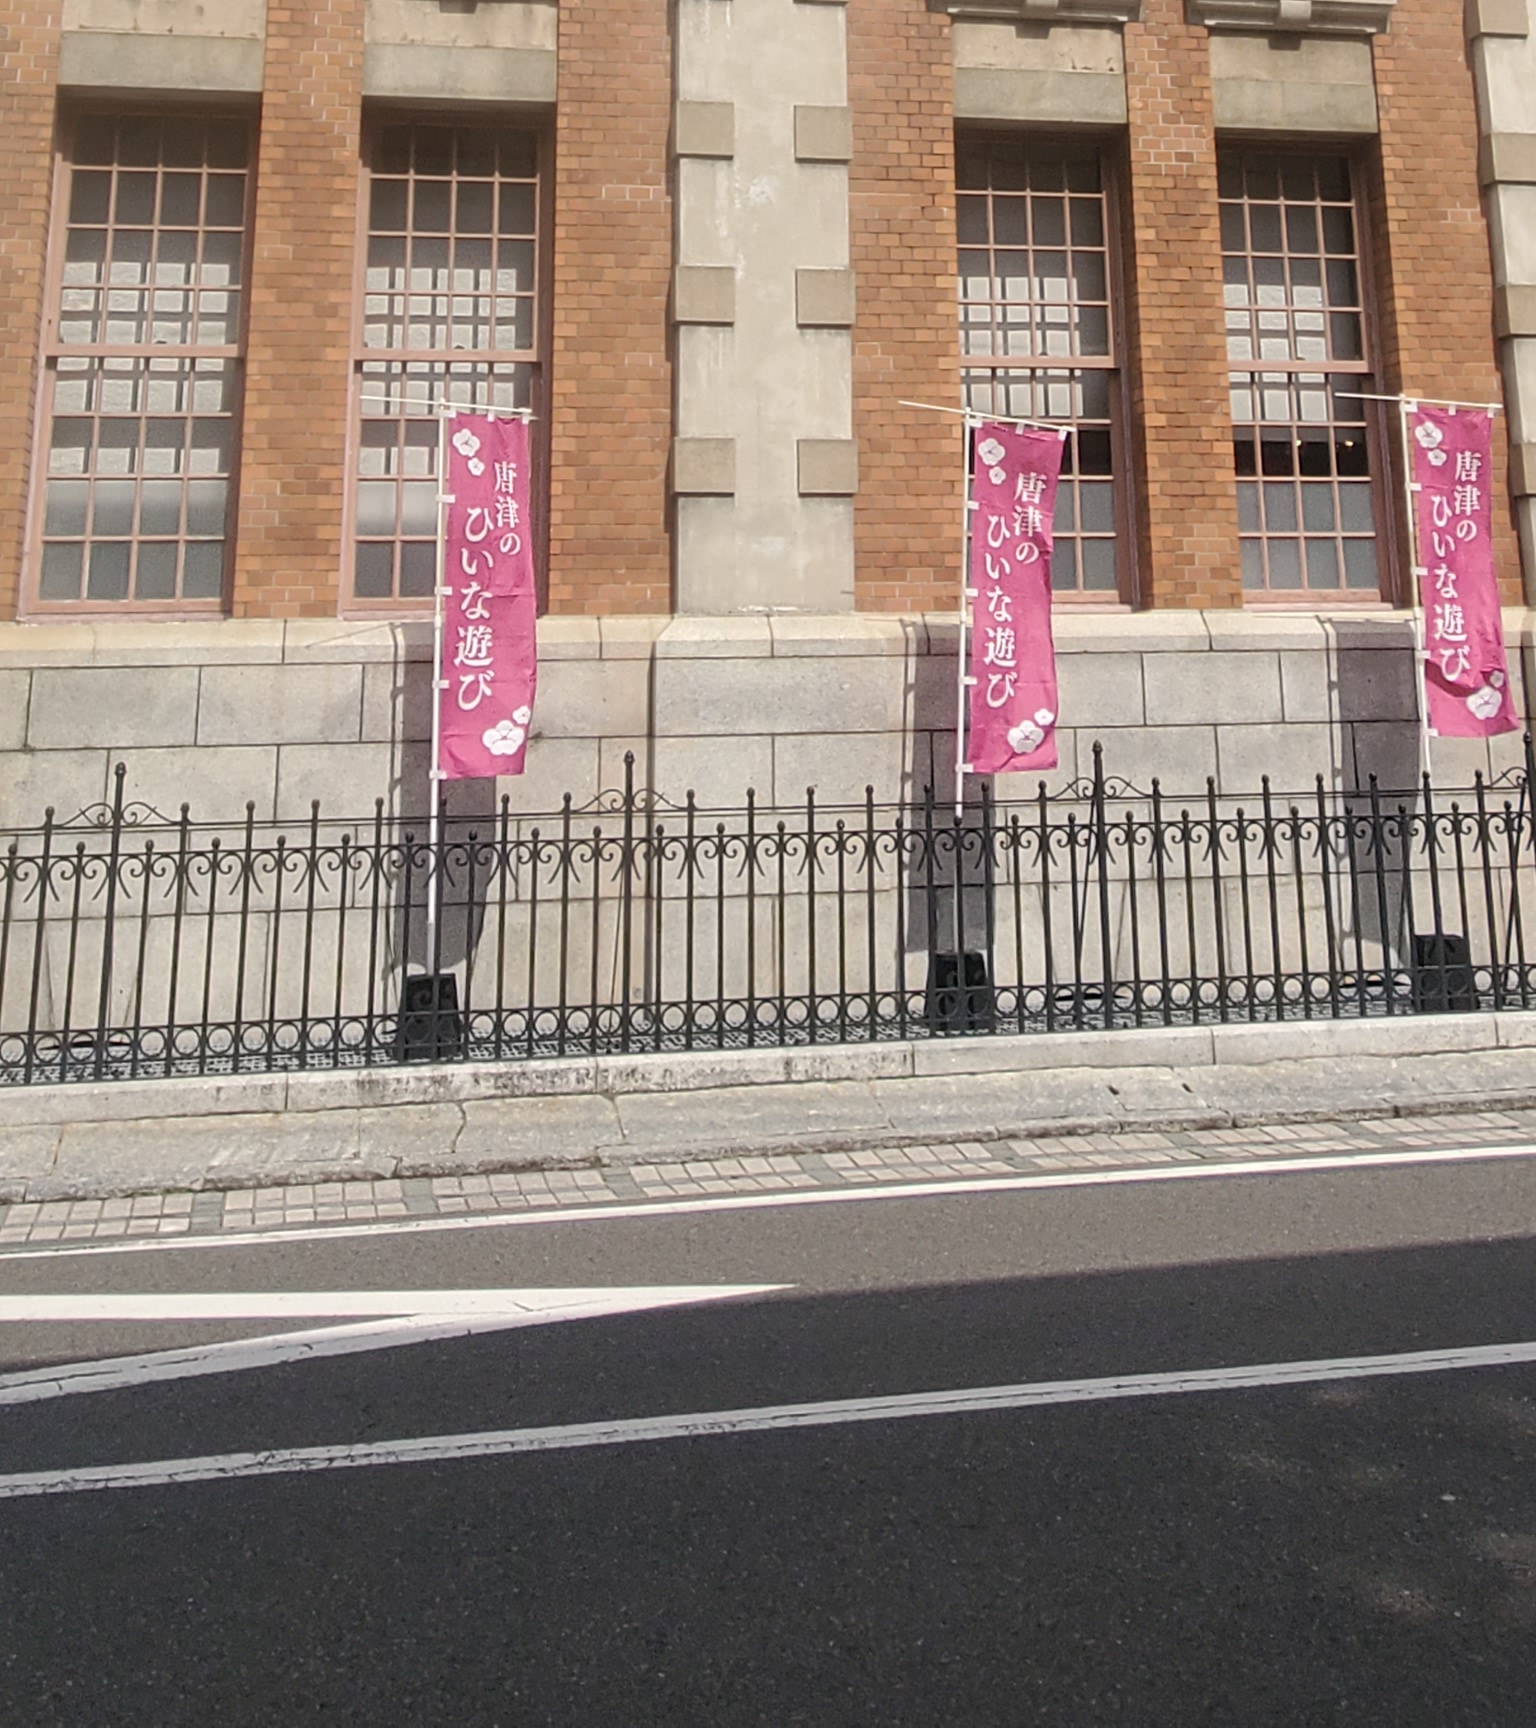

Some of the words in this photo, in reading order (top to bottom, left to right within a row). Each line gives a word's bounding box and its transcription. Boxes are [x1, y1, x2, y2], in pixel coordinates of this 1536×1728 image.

[494, 460, 522, 556] 唐津の
[1012, 472, 1048, 565] 唐津の
[1453, 451, 1482, 543] 唐津の
[454, 505, 495, 712] ひいな遊び
[983, 513, 1018, 709] ひいな遊び
[1431, 494, 1472, 683] ひいな遊び
